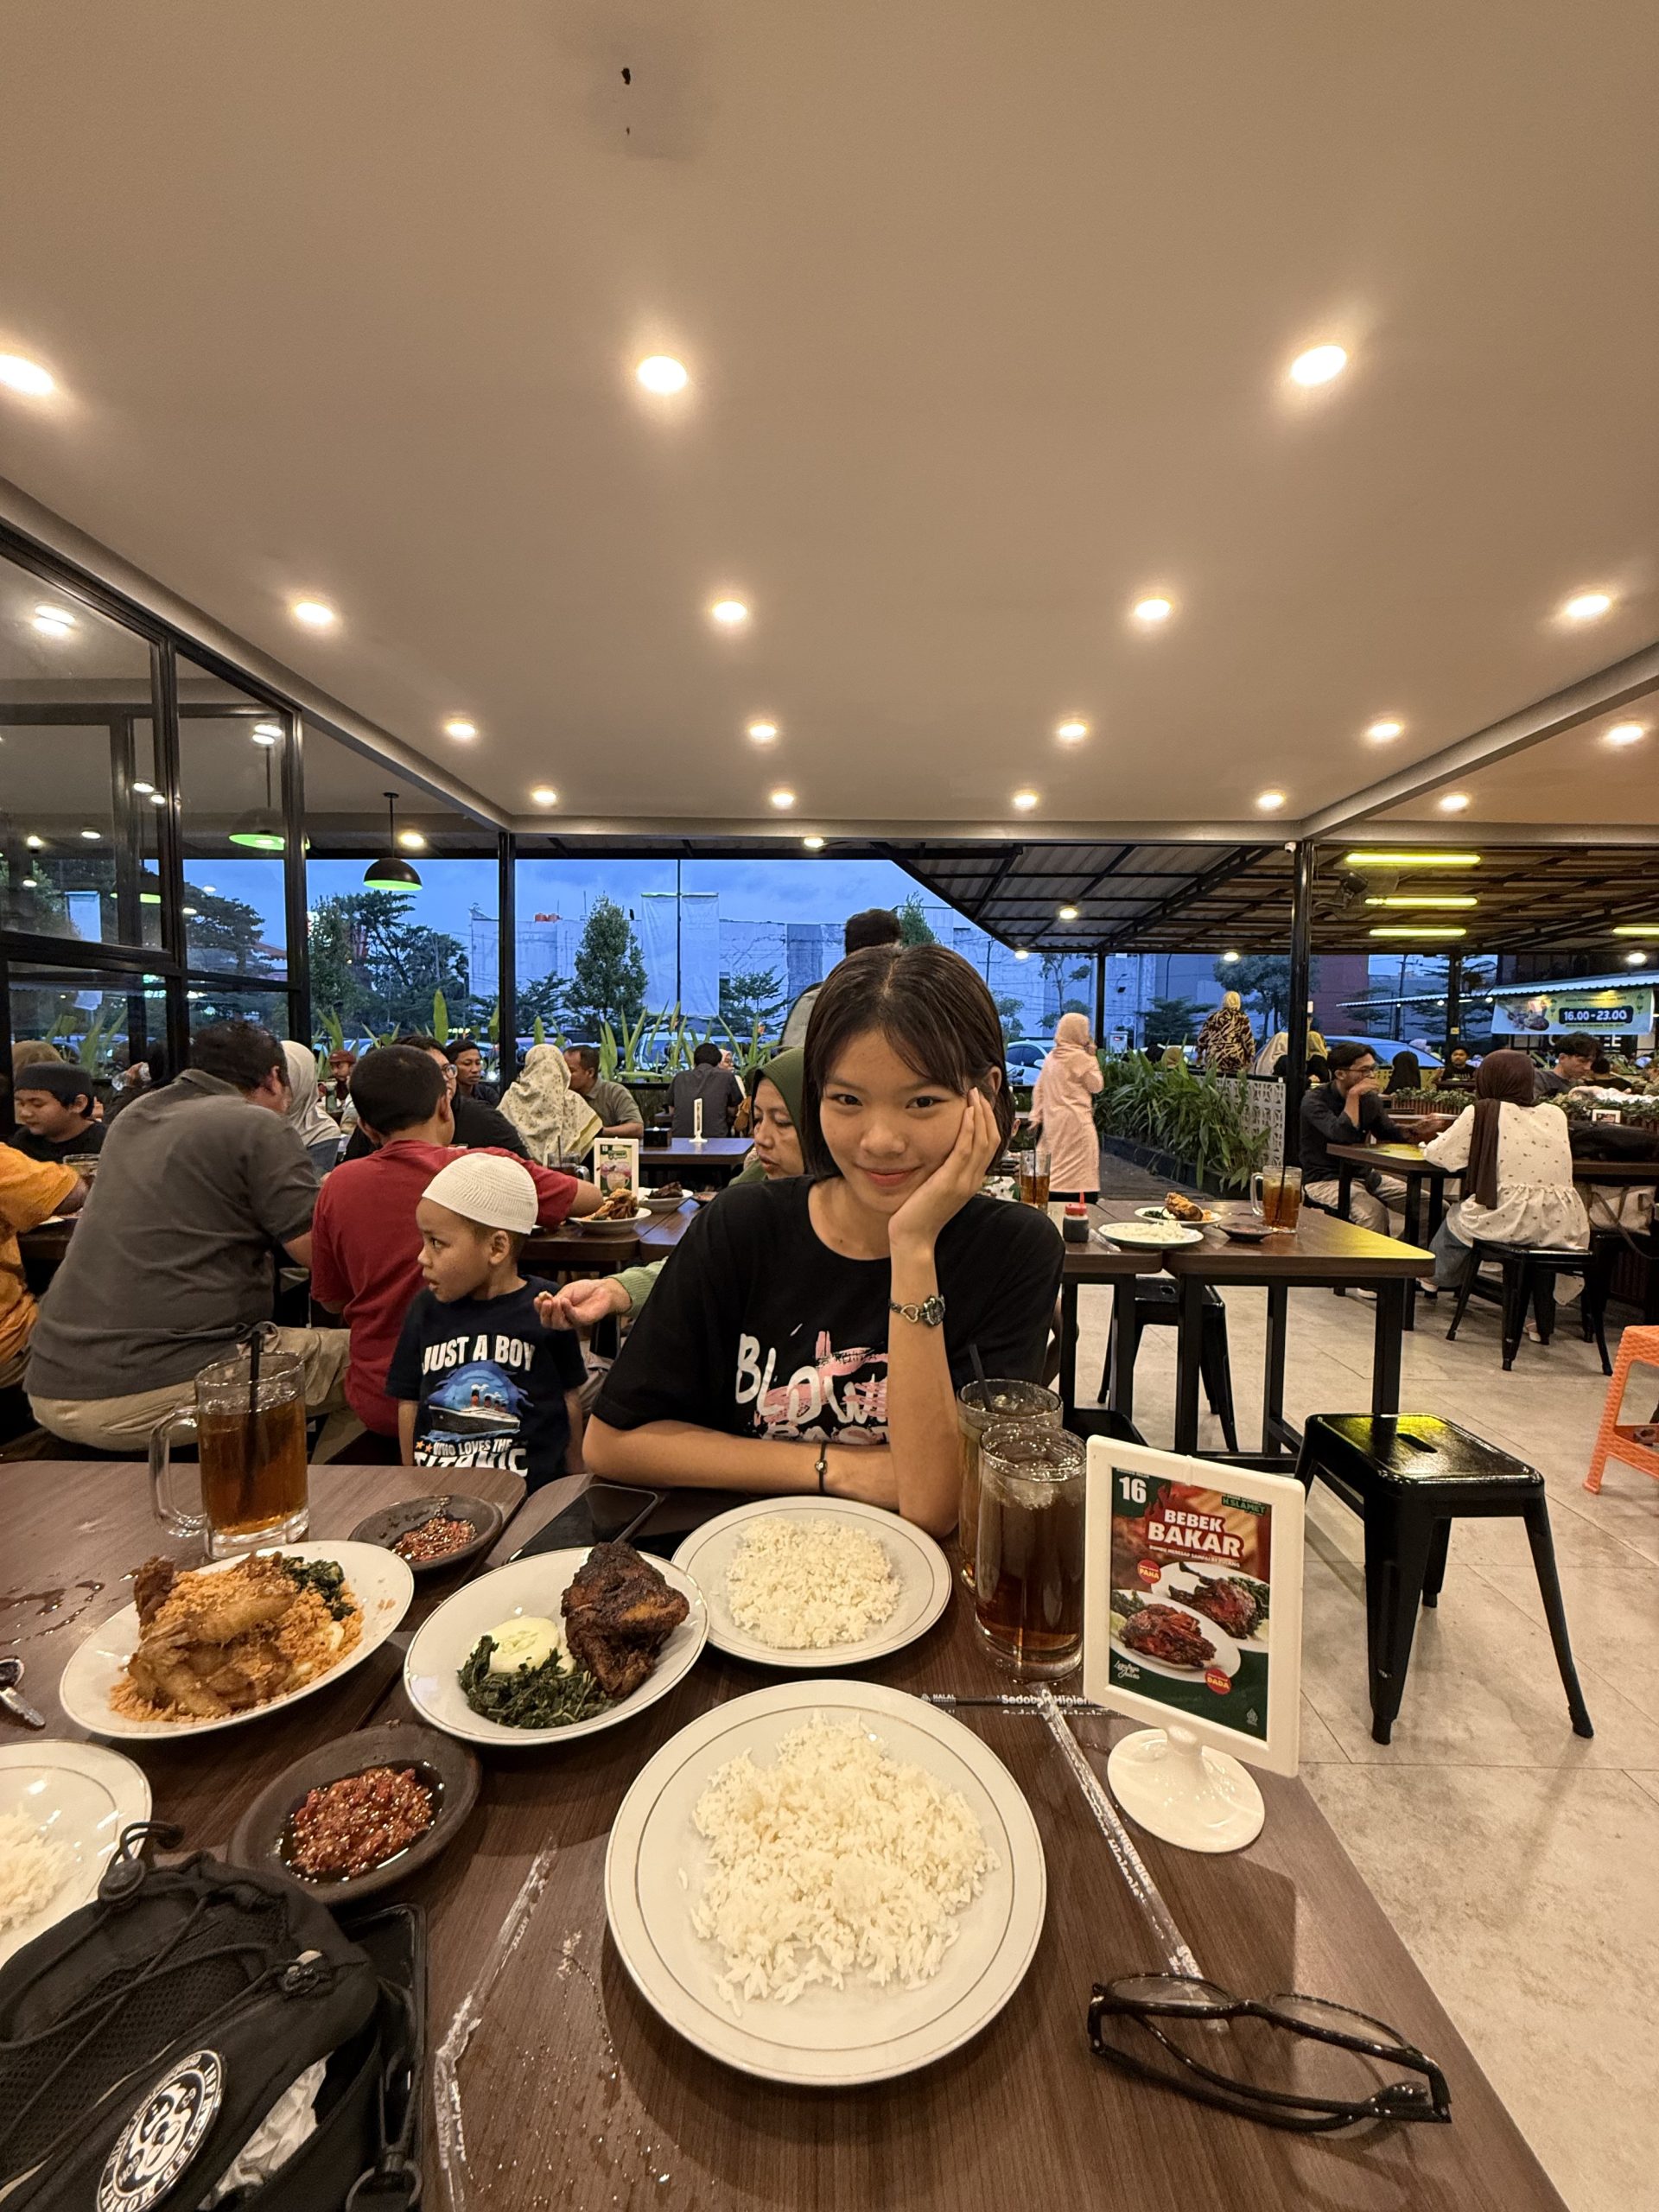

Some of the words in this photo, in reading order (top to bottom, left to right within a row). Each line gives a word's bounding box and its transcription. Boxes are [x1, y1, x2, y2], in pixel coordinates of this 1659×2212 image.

[1564, 1010, 1589, 1021] 16.00
[1596, 1009, 1628, 1020] 23.00
[422, 1336, 470, 1376] JUST
[473, 1334, 488, 1361] A
[494, 1335, 536, 1372] BOY
[433, 1441, 456, 1456] WHO
[458, 1440, 492, 1456] LOVES
[493, 1438, 513, 1452] THE
[1118, 1476, 1147, 1503] 16
[1164, 1509, 1223, 1533] BEBEK
[1147, 1521, 1241, 1557] BAKAR
[1139, 1567, 1160, 1580] PAHA
[1206, 1676, 1230, 1689] DADA
